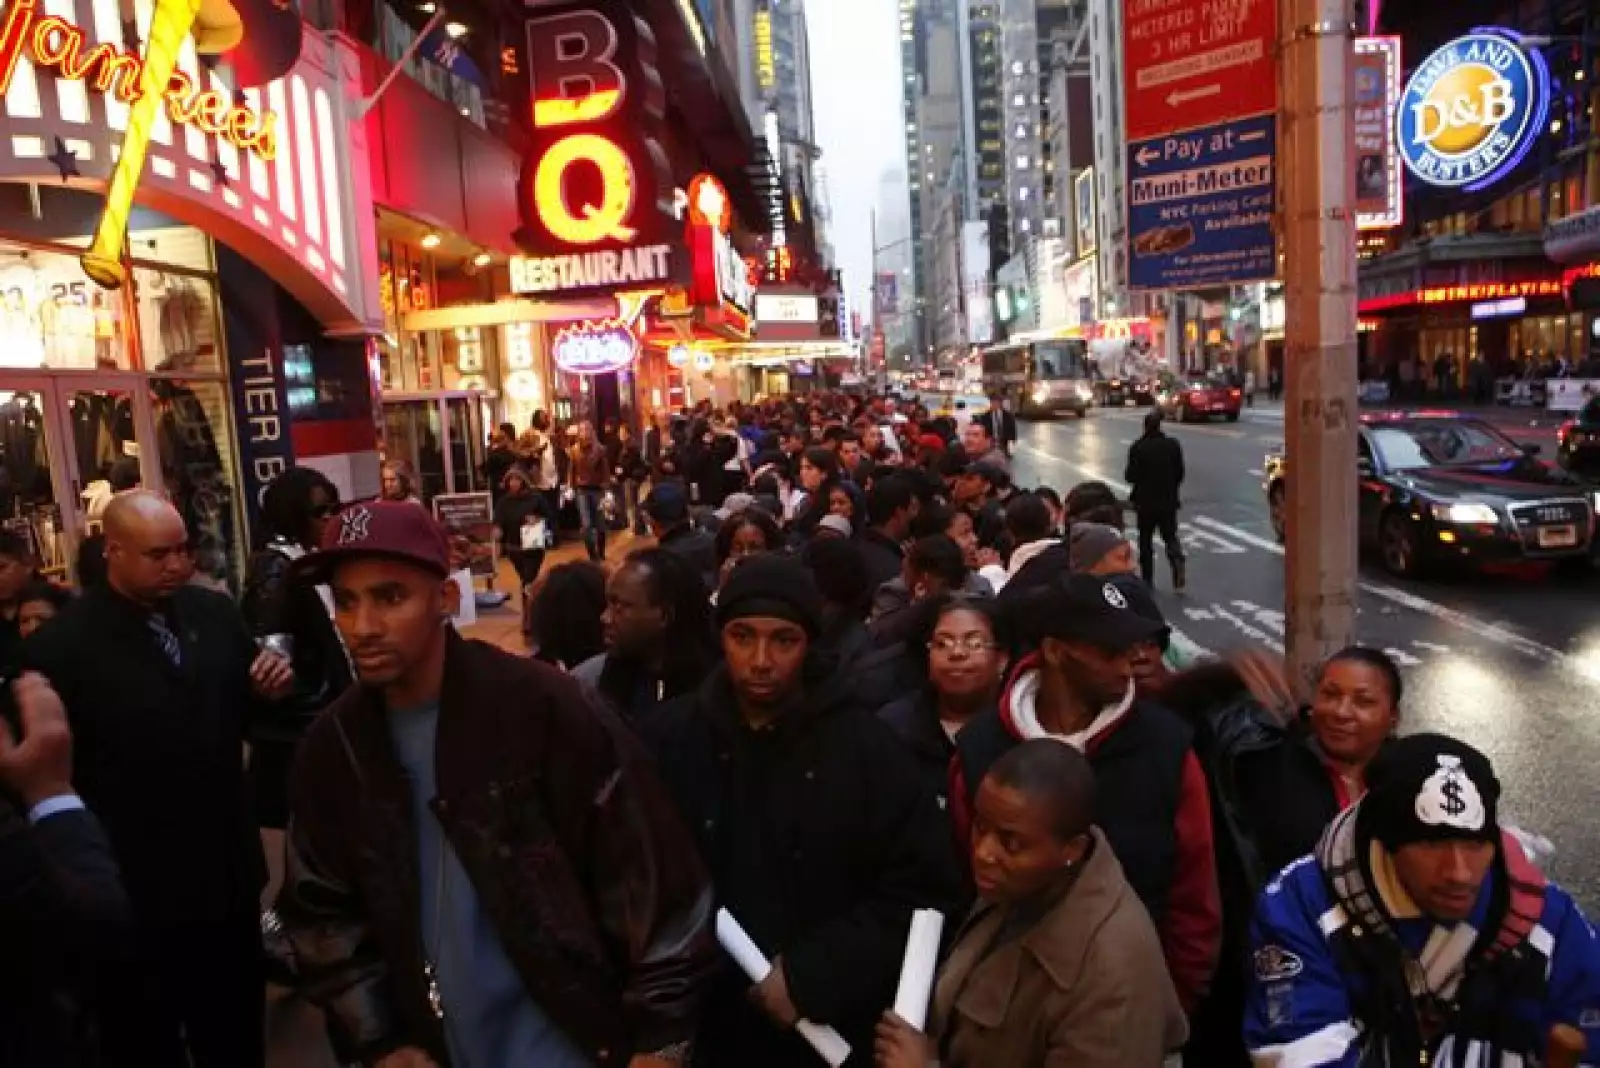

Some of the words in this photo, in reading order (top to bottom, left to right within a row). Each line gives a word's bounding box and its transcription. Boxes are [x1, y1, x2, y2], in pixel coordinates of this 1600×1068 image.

[1170, 32, 1191, 53] HR
[1200, 17, 1244, 44] LIMIT
[1465, 41, 1513, 71] AND
[525, 0, 640, 243] BQ
[1411, 79, 1516, 145] D&B
[1165, 138, 1204, 162] Pay
[1210, 130, 1235, 152] at
[1134, 165, 1269, 201] Muni-Meter
[509, 245, 670, 292] RESTAURANT
[241, 347, 280, 442] TIER
[254, 456, 286, 512] B
